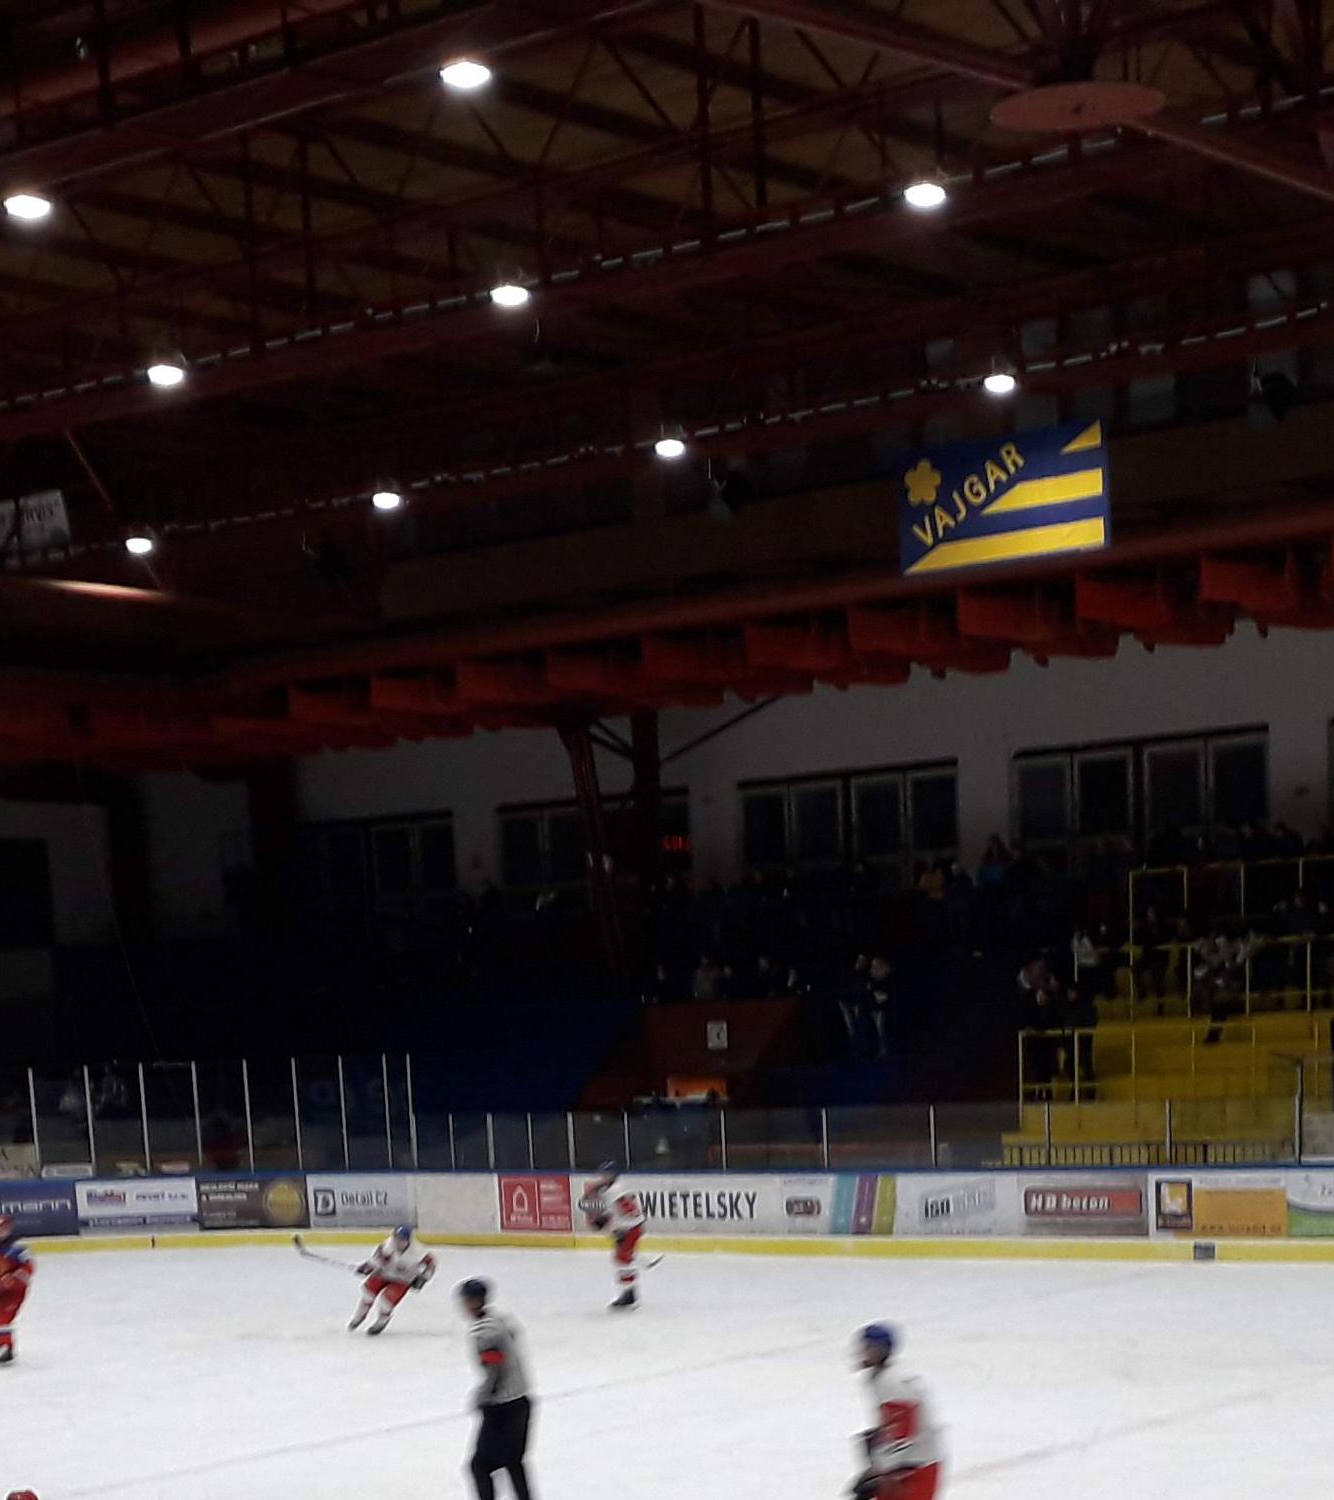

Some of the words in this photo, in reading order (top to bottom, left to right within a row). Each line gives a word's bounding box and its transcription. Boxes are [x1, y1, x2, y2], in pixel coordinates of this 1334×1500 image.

[912, 441, 1025, 548] VAJGAR
[639, 1191, 758, 1219] WIETELSKY
[1062, 1195, 1109, 1211] beton
